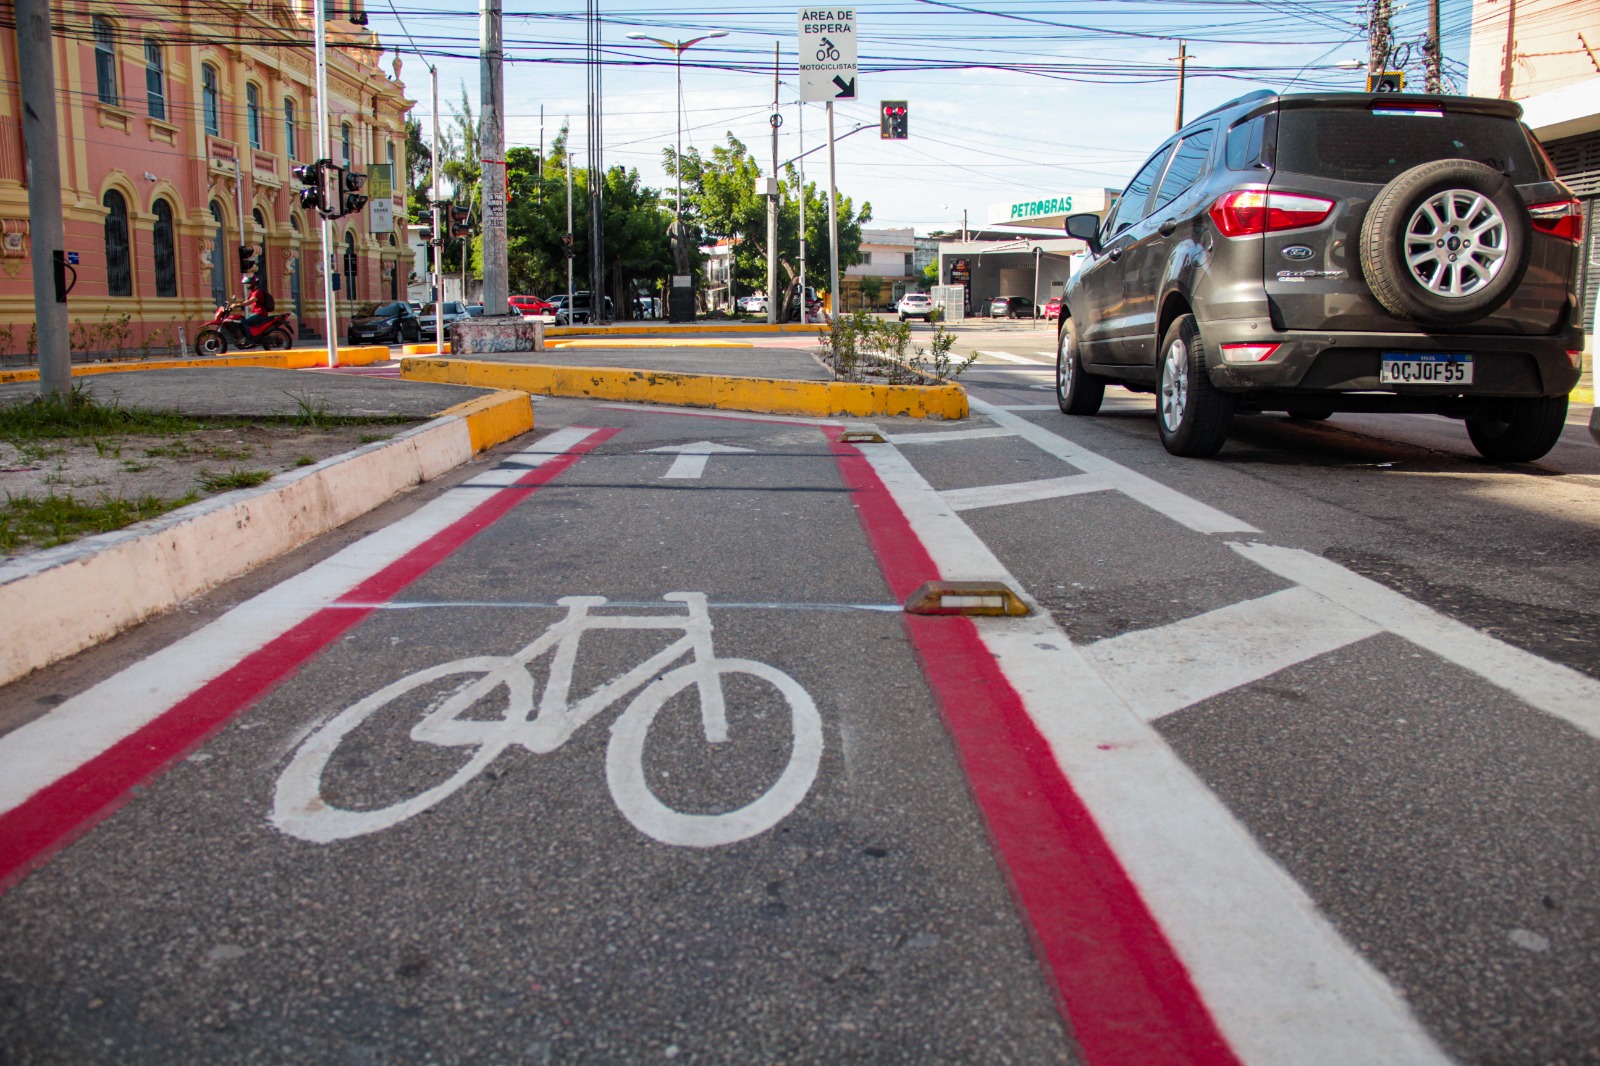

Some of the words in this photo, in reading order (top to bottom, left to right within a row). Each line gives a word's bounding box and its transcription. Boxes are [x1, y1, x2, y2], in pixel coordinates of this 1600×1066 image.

[802, 9, 834, 20] ÁREA
[837, 10, 853, 20] DE
[804, 23, 851, 33] ESPERA
[800, 63, 857, 71] MOTOCICLISTAS
[1011, 196, 1072, 218] PETROBRAS
[1289, 248, 1306, 256] Ford
